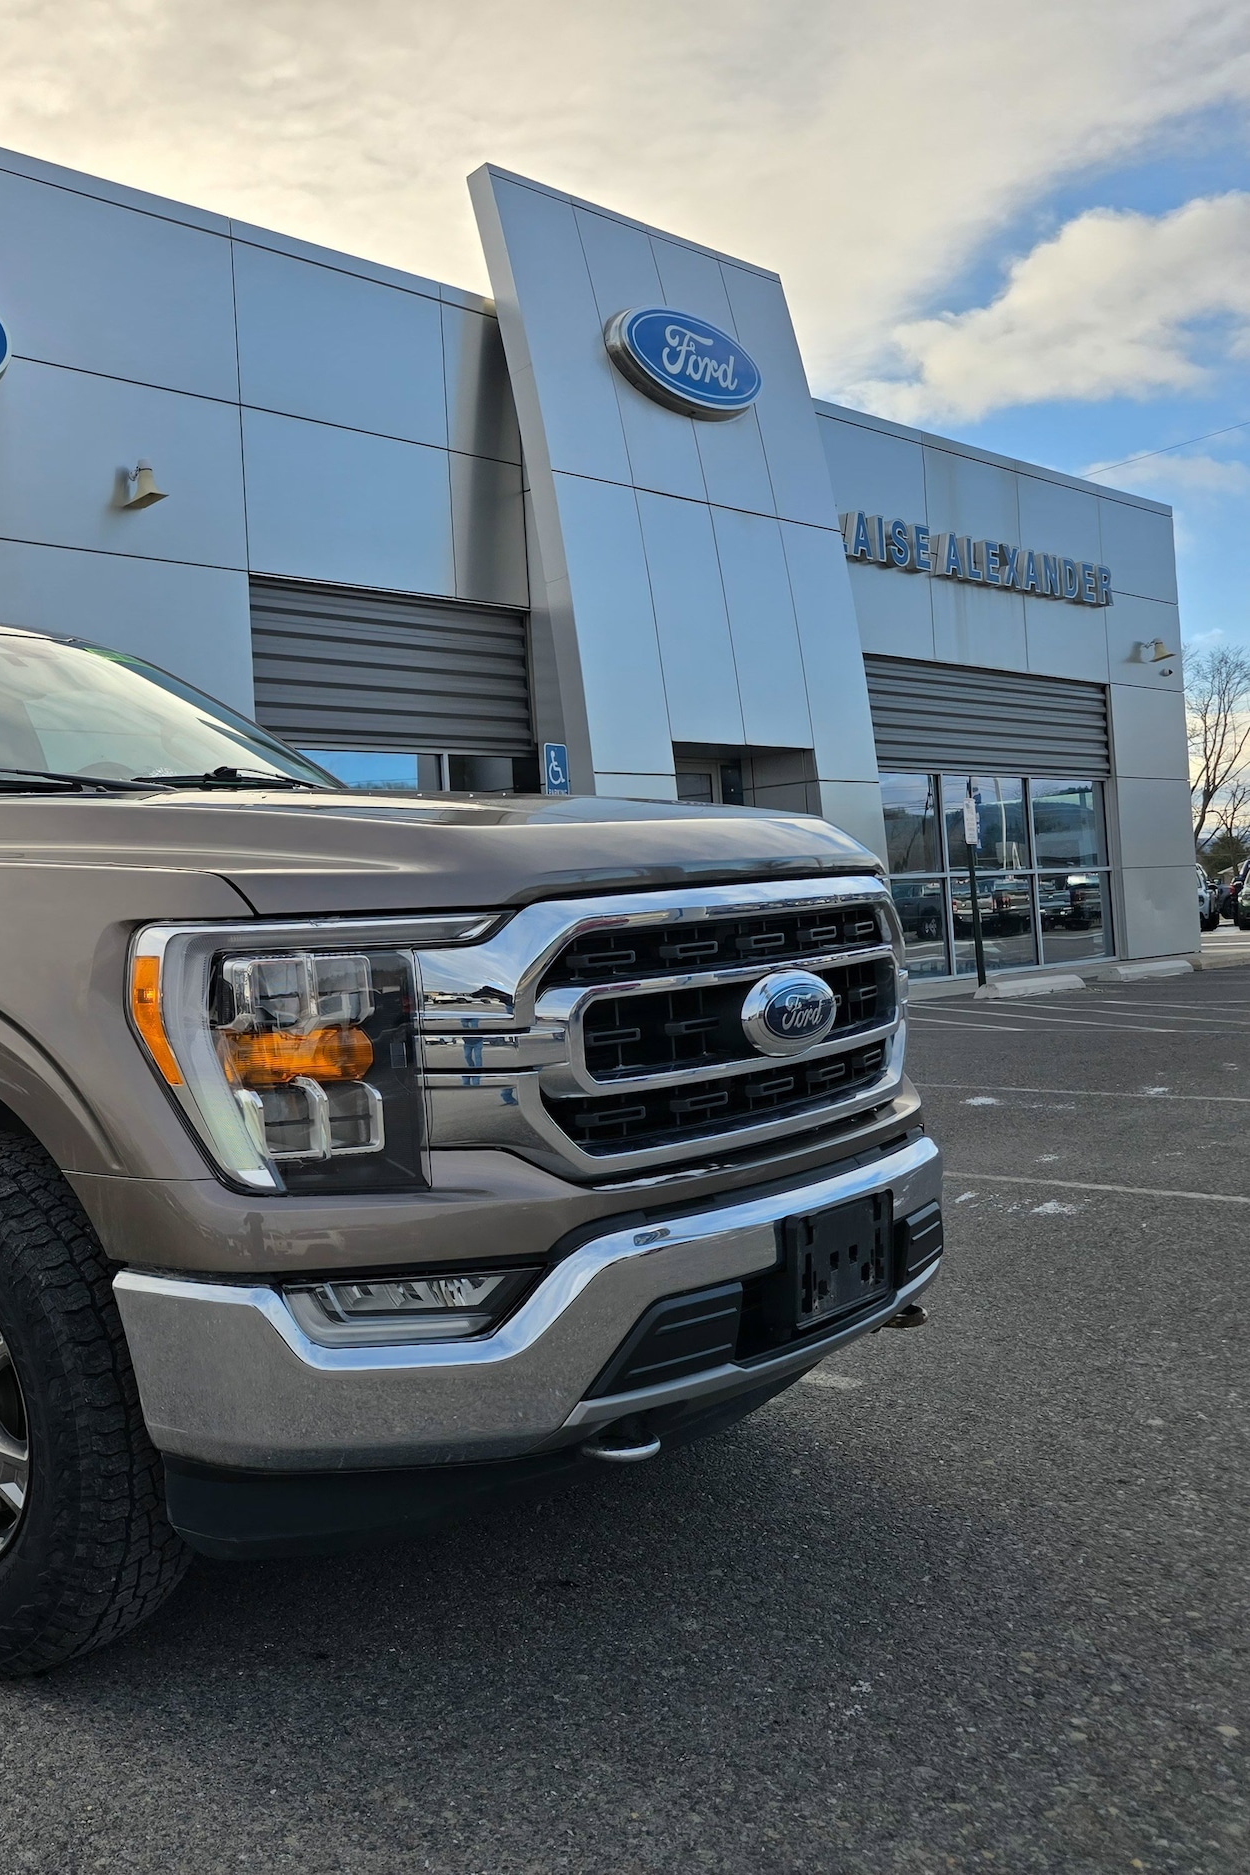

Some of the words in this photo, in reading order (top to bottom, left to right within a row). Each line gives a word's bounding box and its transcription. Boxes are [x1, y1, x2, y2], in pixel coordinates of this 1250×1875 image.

[662, 325, 738, 391] Ford
[842, 510, 932, 571] AISE
[944, 531, 1114, 606] ALEXANDER
[782, 993, 824, 1031] Ford
